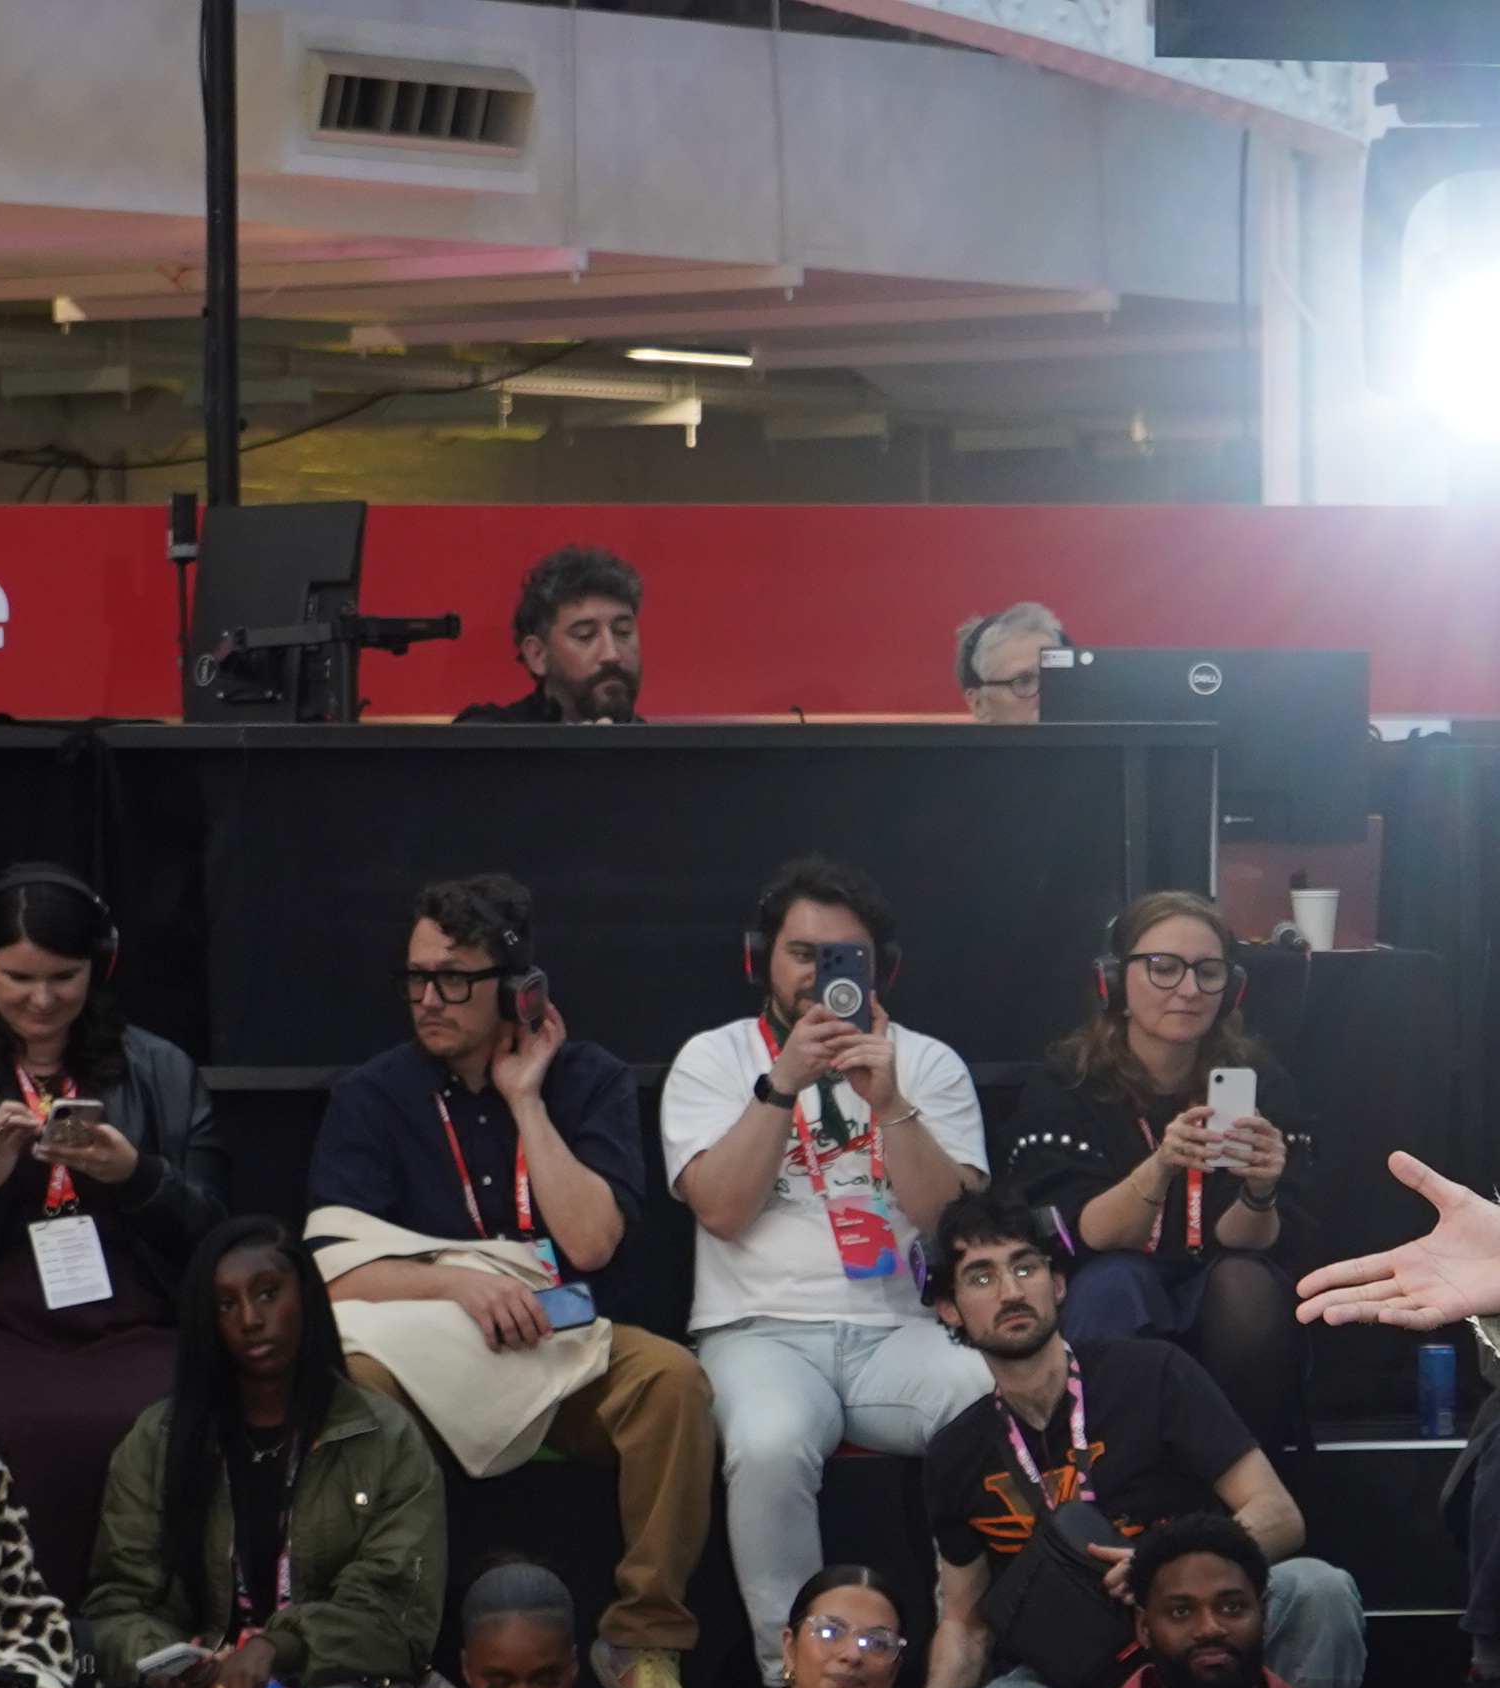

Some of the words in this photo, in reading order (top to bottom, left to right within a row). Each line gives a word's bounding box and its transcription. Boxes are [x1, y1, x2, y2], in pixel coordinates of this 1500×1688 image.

[516, 1175, 532, 1214] Adobe
[1189, 1191, 1201, 1229] Adobe
[1018, 1448, 1041, 1484] Adobe
